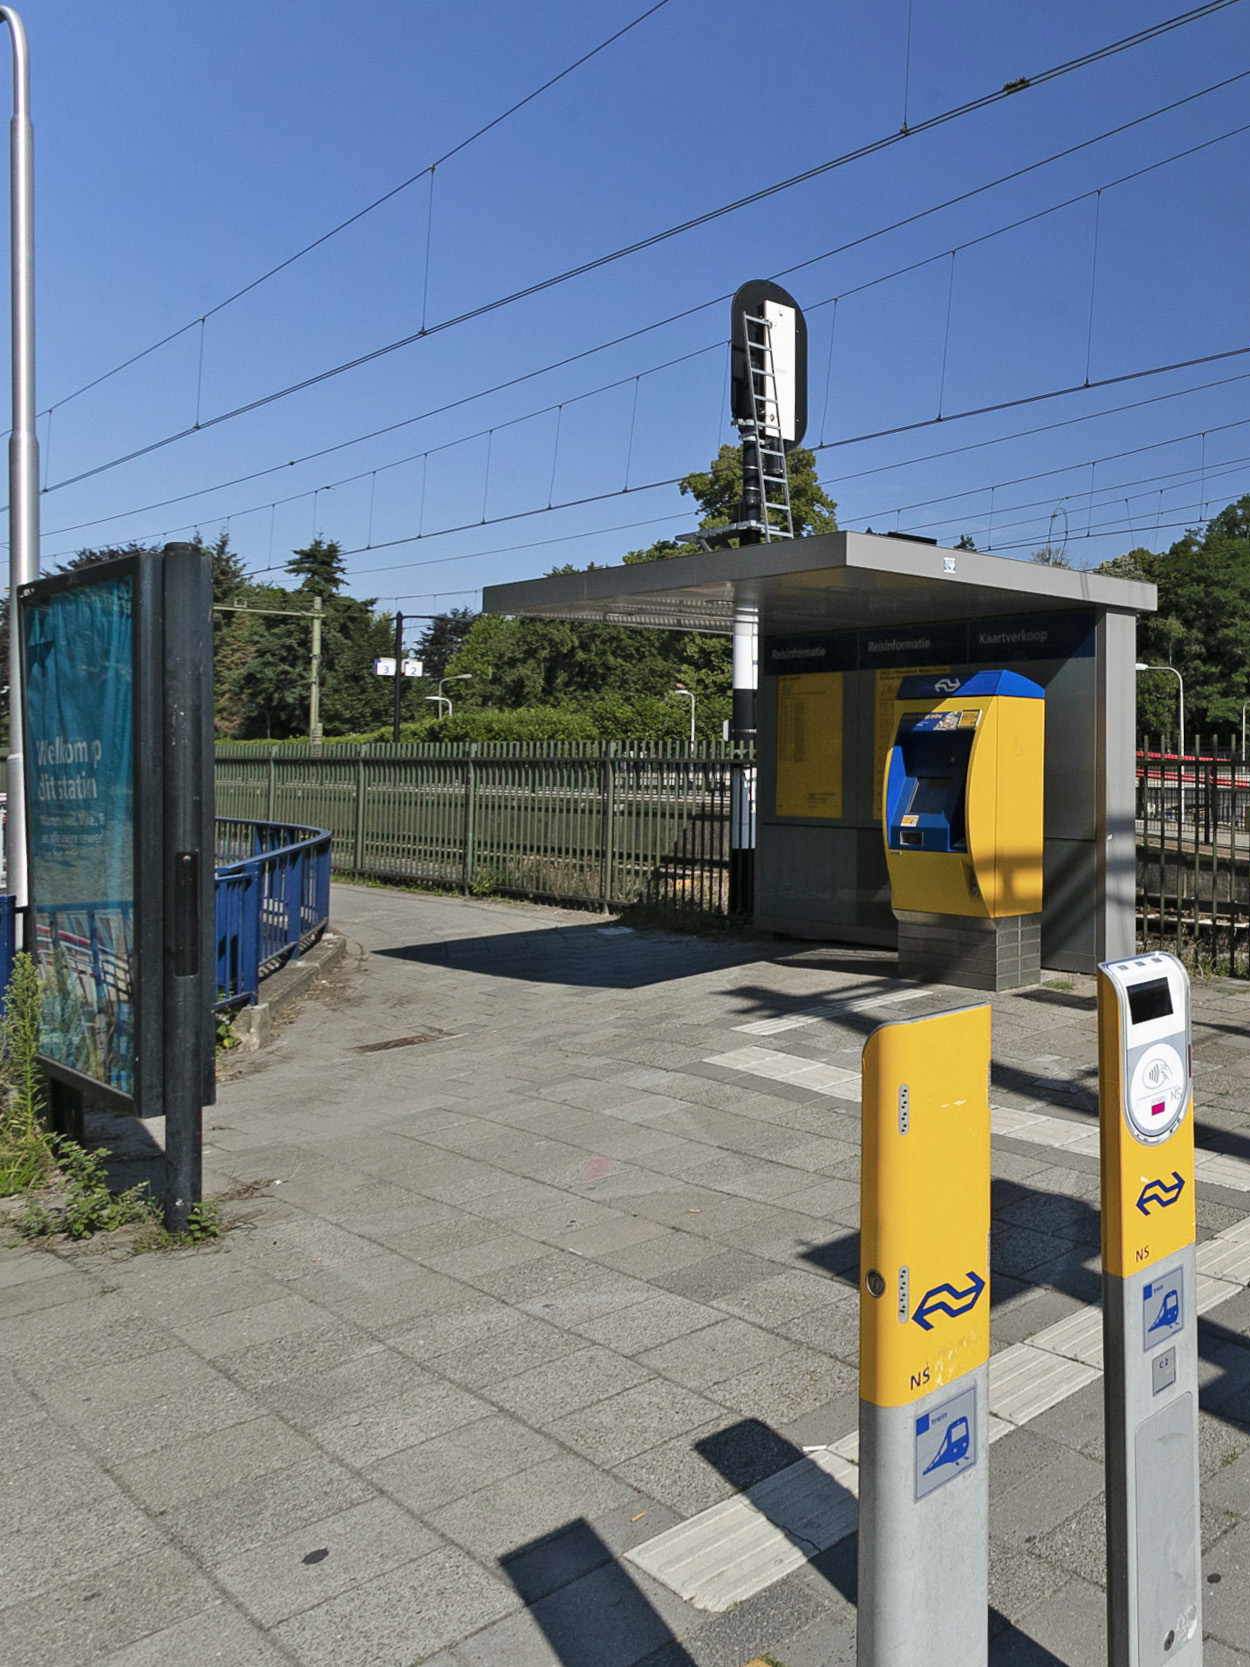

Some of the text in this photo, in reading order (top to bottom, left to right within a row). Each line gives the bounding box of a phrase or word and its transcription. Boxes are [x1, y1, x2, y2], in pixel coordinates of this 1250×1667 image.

[868, 636, 931, 652] Reisinformatie
[979, 629, 1048, 645] Kaartverkoop
[771, 645, 826, 660] Reisinformatie
[384, 666, 390, 674] 3
[410, 667, 417, 675] 2
[1135, 1245, 1150, 1263] NS
[910, 1366, 930, 1391] NS
[931, 1412, 948, 1426] trein
